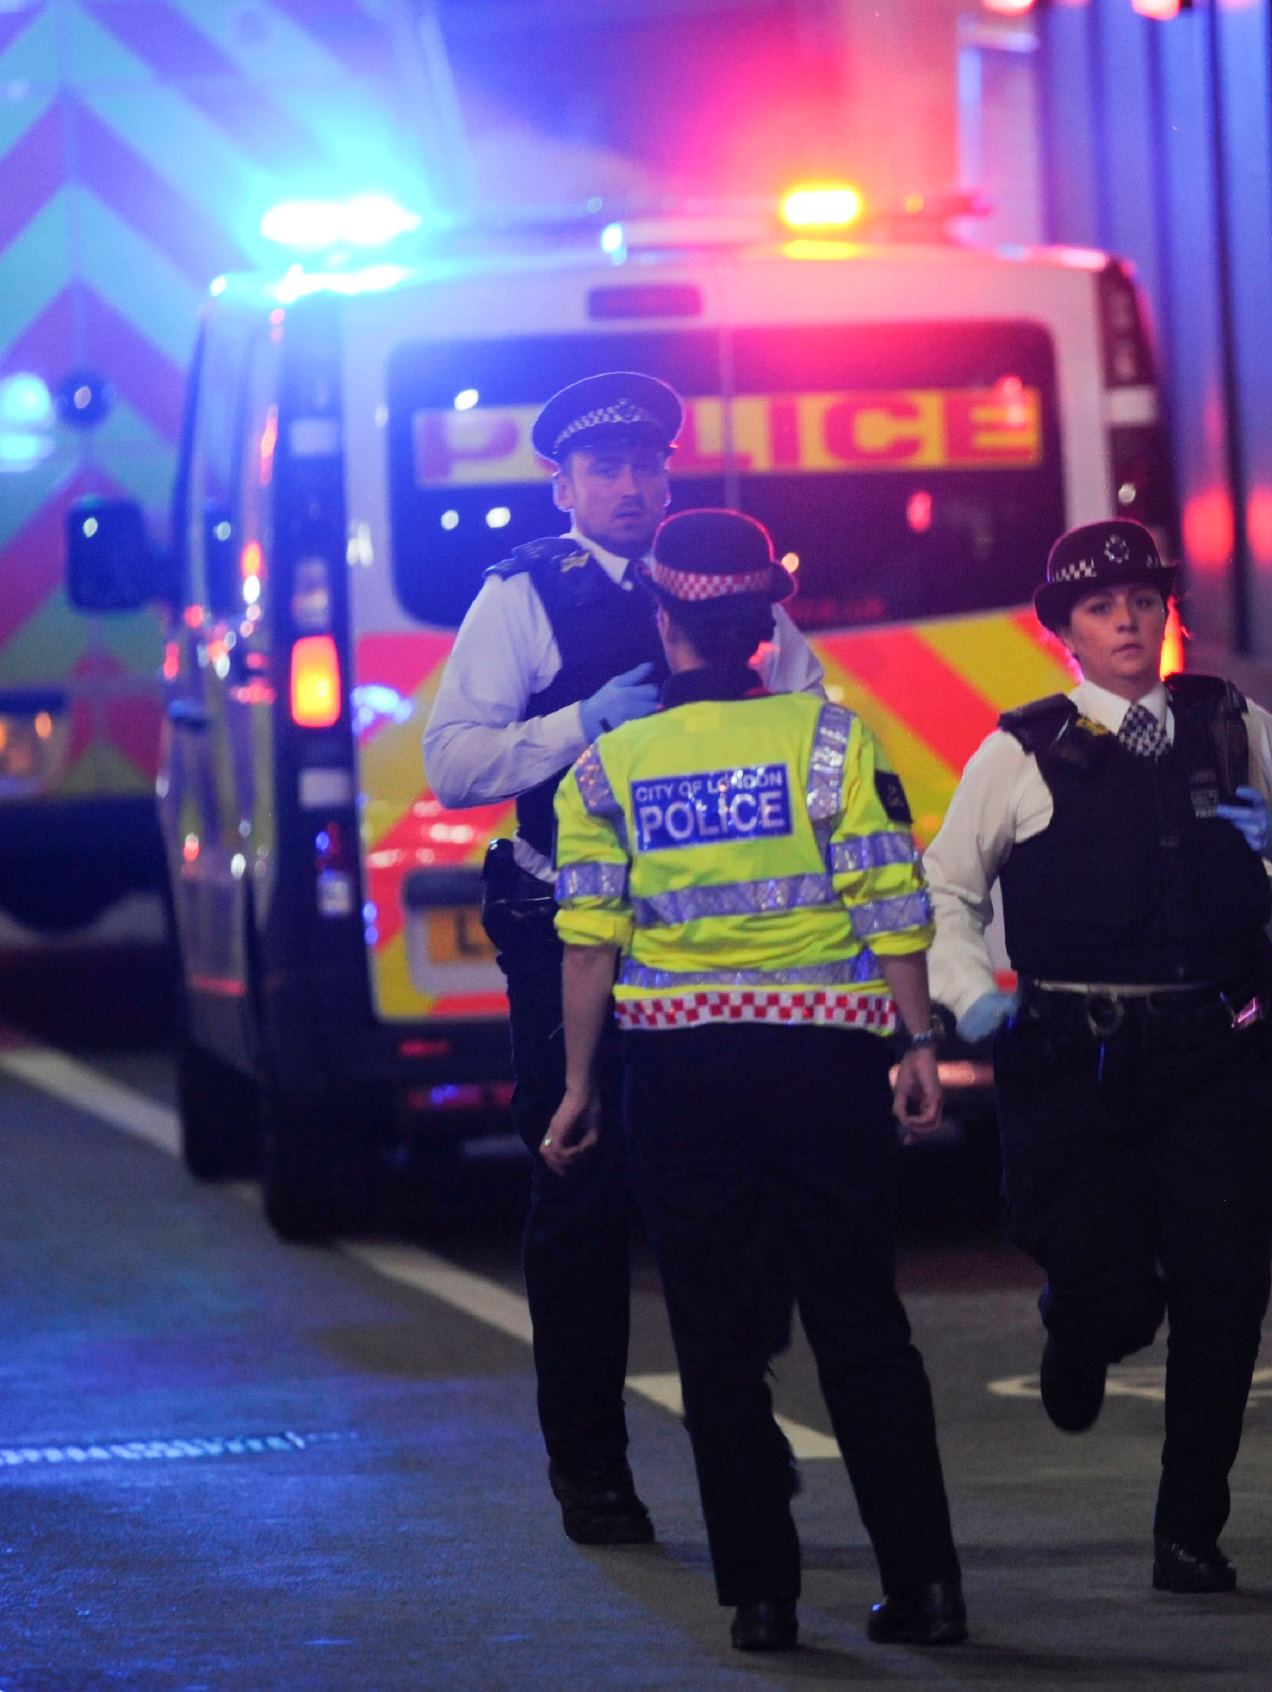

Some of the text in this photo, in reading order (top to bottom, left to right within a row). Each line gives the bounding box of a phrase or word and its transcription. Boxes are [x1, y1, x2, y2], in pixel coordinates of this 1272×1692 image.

[421, 391, 1037, 479] PLICE
[635, 782, 675, 802] CITY
[678, 780, 702, 796] OF
[638, 791, 786, 844] POLICE
